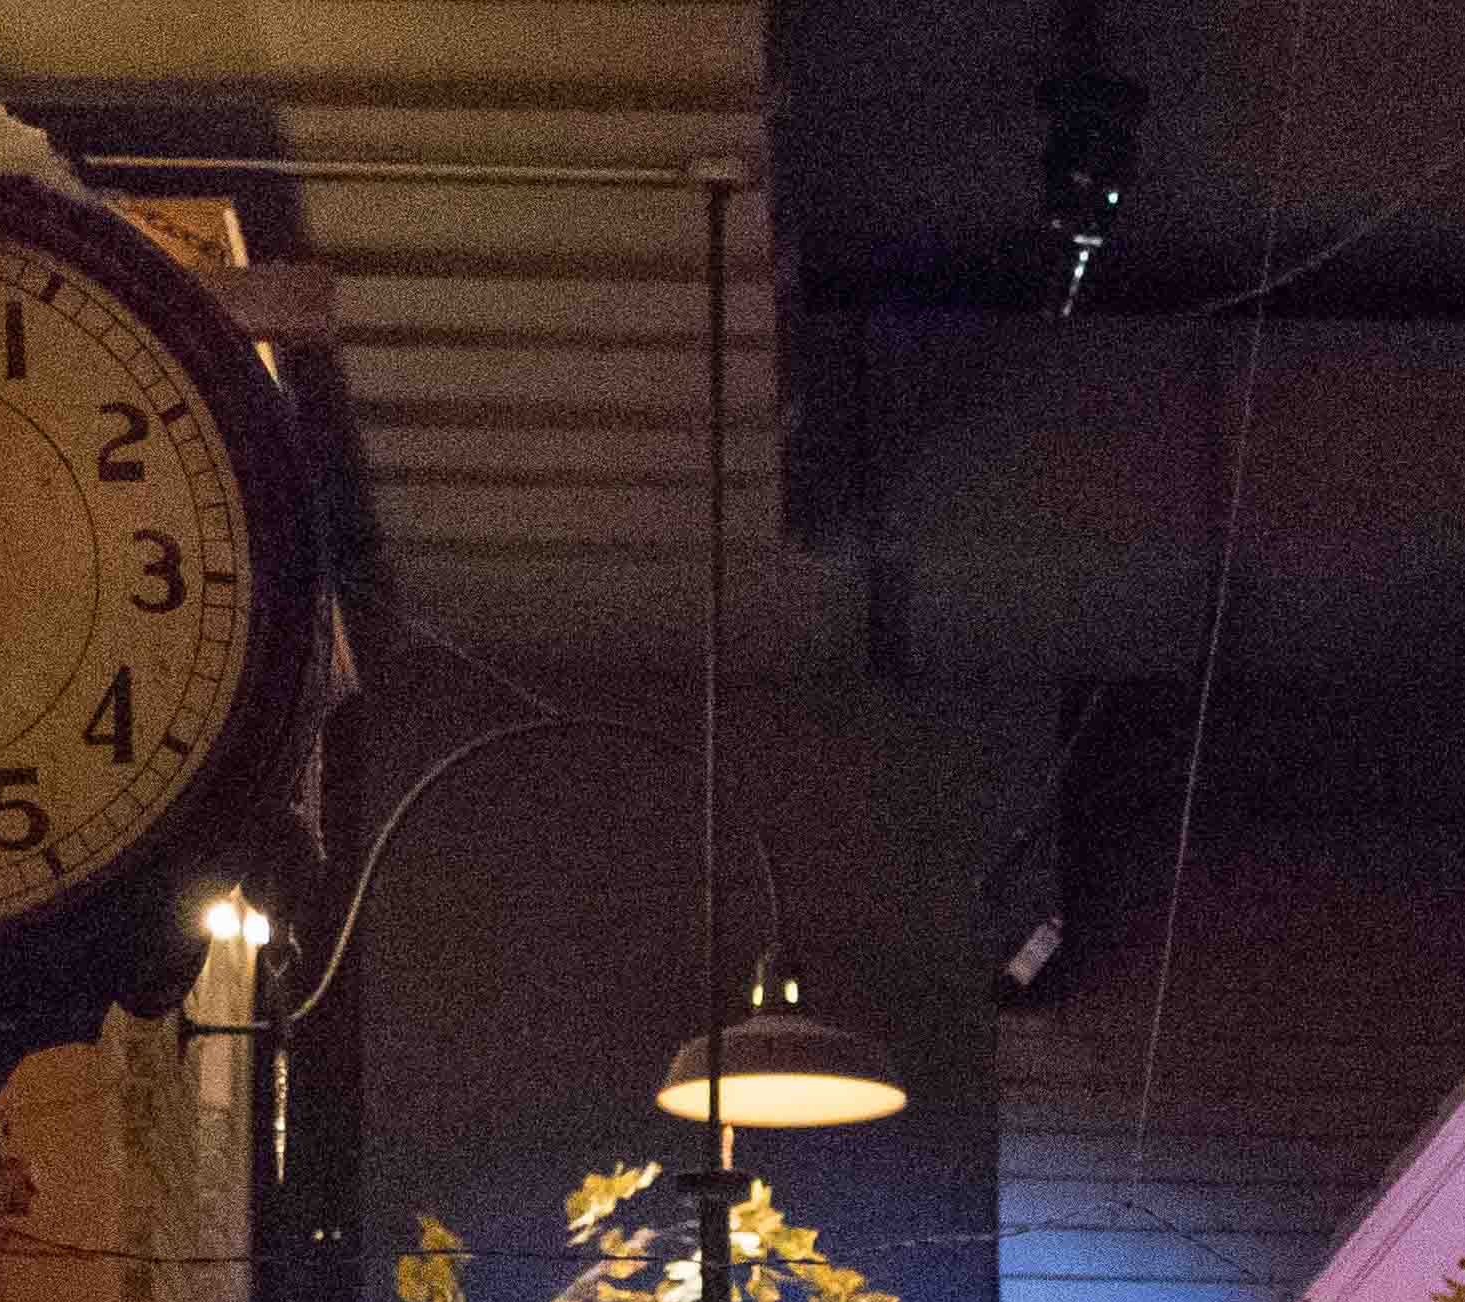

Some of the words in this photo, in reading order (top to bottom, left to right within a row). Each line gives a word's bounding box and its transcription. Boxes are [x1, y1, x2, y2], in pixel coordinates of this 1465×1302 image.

[6, 302, 25, 378] 1
[99, 402, 148, 481] 2
[134, 530, 185, 613] 3
[84, 666, 134, 763] 4
